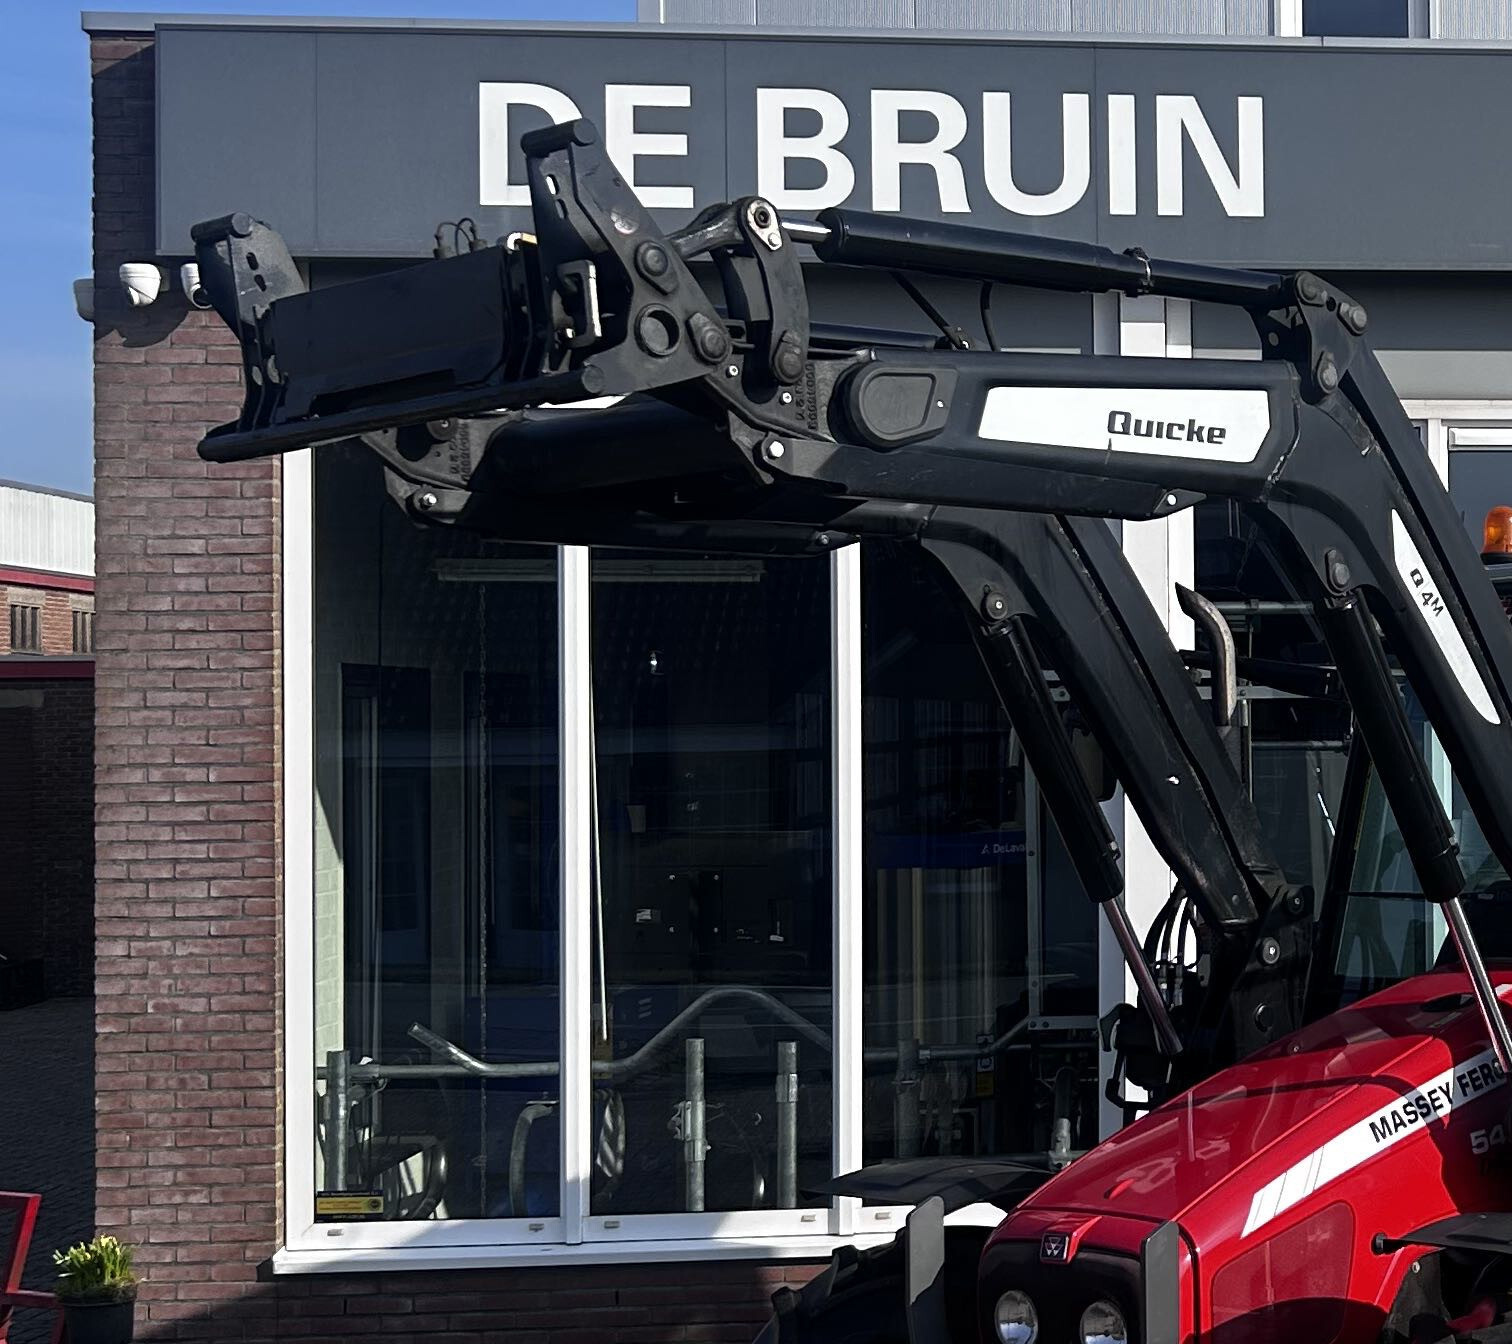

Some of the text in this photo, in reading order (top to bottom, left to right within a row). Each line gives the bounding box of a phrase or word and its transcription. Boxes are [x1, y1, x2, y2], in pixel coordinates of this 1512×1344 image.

[479, 81, 1266, 219] DE BRUIN
[1106, 409, 1228, 447] Quicke
[992, 843, 1027, 854] DeLava
[1368, 1081, 1454, 1144] MASSEY
[1469, 1124, 1506, 1155] 54
